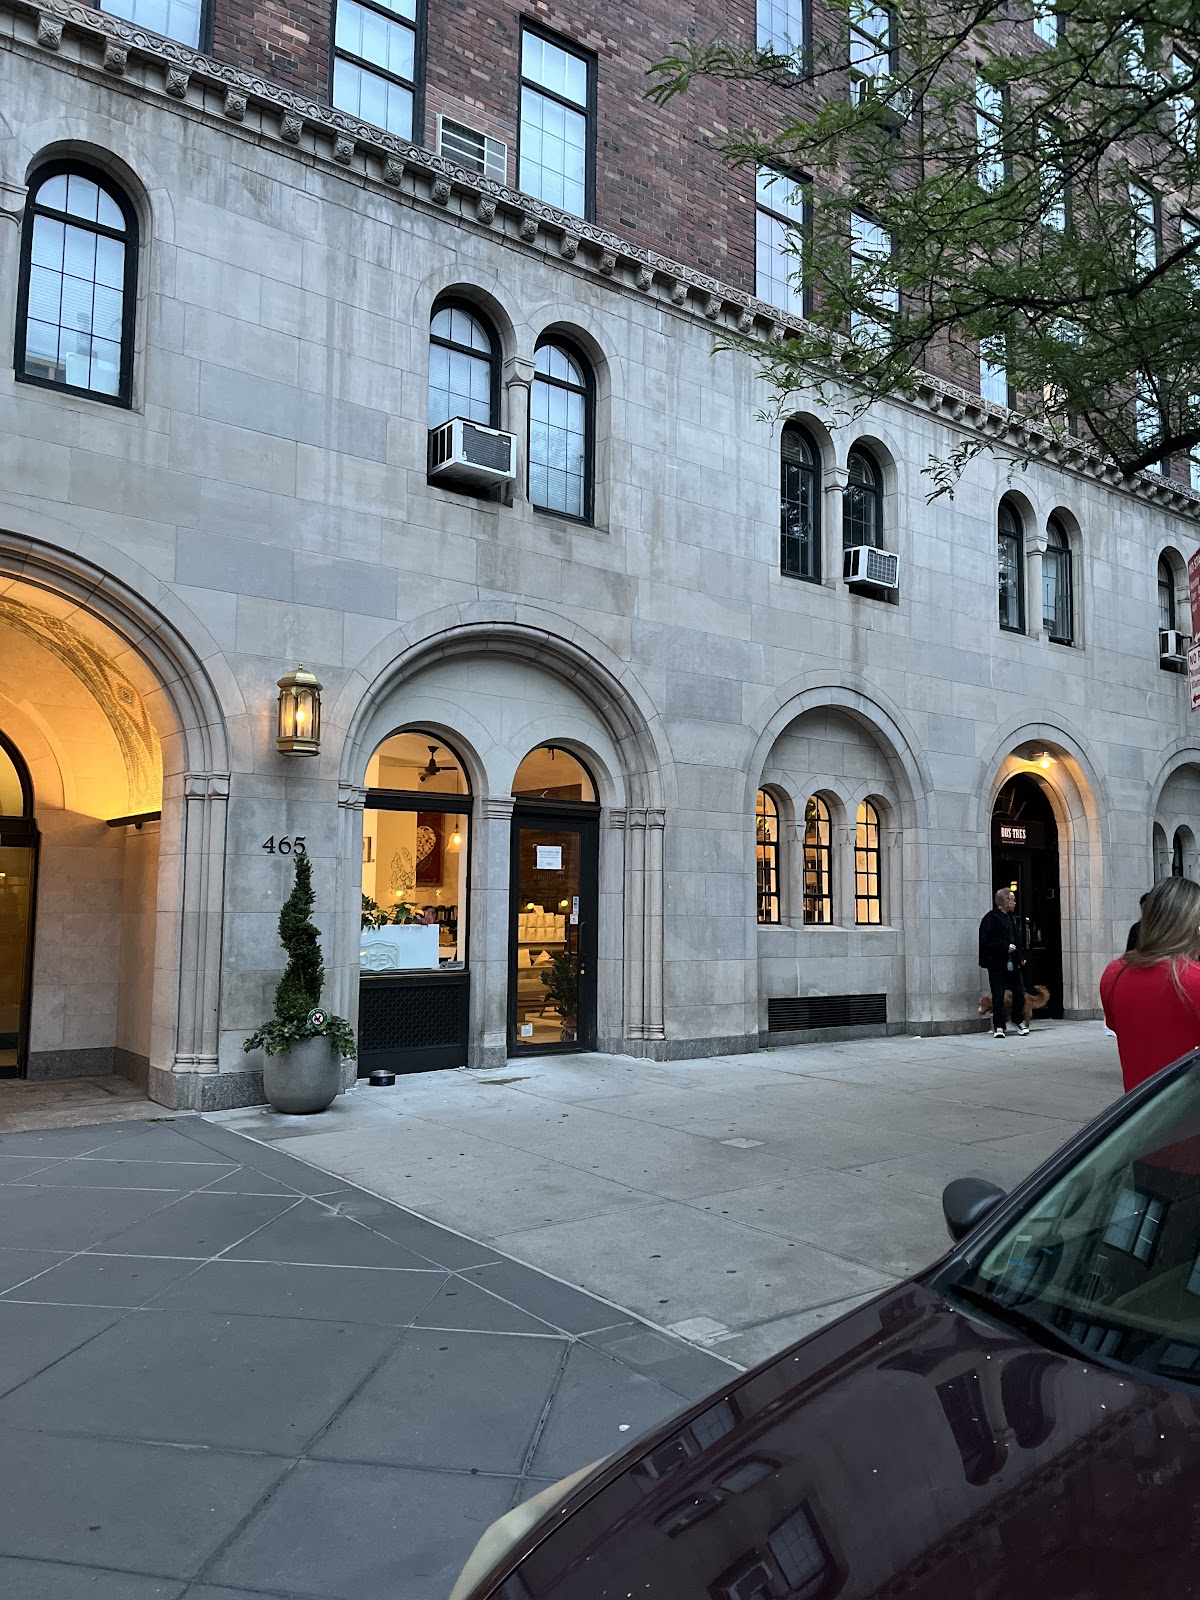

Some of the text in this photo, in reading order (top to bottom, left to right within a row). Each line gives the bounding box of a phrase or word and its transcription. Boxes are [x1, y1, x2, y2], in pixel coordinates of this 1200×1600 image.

[1189, 652, 1197, 666] NO
[262, 835, 306, 855] 465
[360, 954, 396, 966] OPEN
